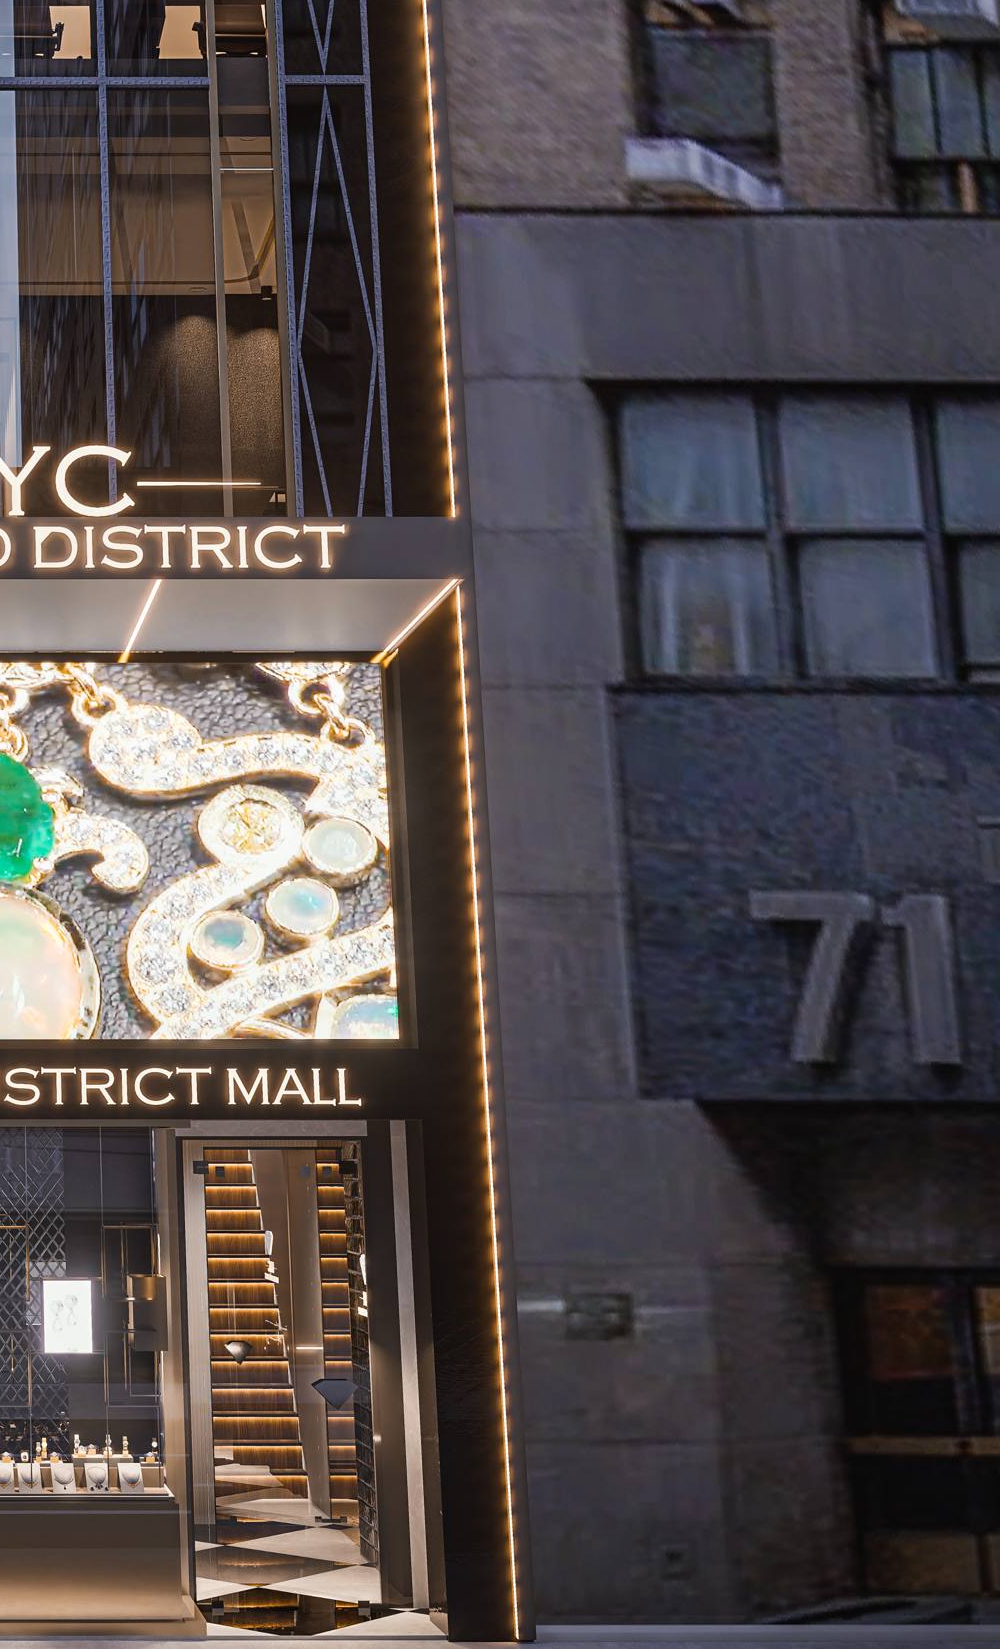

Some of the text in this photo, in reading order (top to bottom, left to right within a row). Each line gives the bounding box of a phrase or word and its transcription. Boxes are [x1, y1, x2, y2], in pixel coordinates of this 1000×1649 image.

[33, 524, 345, 570] DISTRICT
[749, 890, 963, 1065] 71
[227, 1067, 362, 1107] MALL
